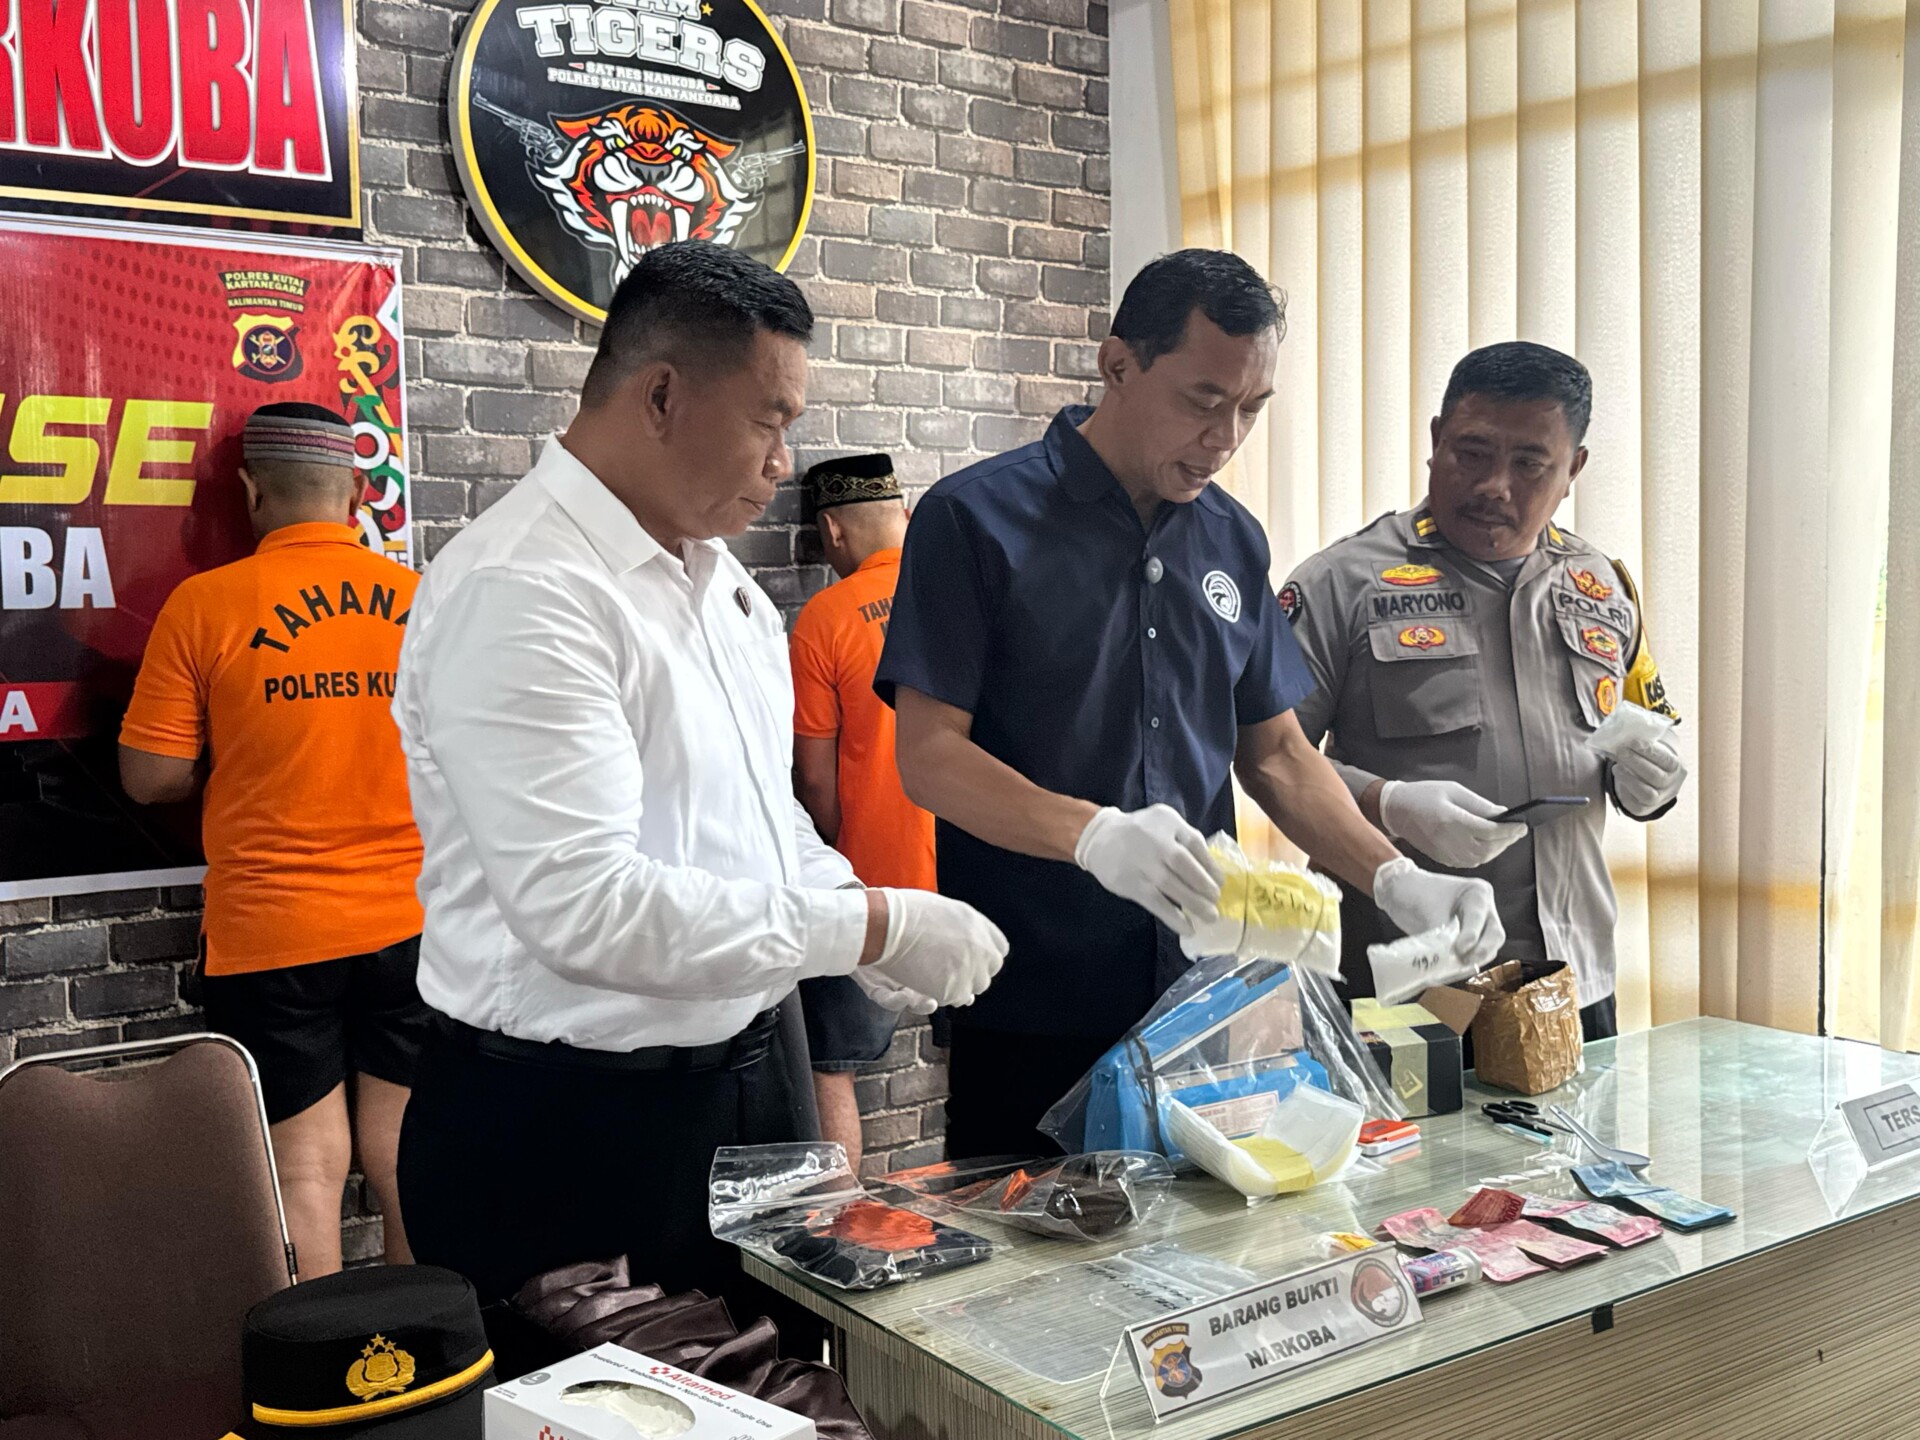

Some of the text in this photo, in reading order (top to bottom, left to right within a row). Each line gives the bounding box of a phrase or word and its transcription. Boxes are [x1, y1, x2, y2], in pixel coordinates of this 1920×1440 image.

[516, 4, 766, 92] TIGERS
[547, 67, 599, 89] POLRES
[601, 76, 643, 96] KUTAI
[585, 61, 615, 79] SAT
[616, 66, 642, 82] RES
[0, 0, 332, 182] KOBA
[225, 273, 304, 288] POLRES KUTAI
[225, 280, 304, 296] KARTANEGARA
[228, 298, 304, 312] KALIMANTAN TIMUR
[0, 394, 214, 506] SE
[0, 526, 116, 610] BA
[858, 596, 893, 623] TAH
[1373, 592, 1465, 617] MARYONO
[1559, 592, 1628, 631] POLRI
[264, 671, 360, 703] POLRES
[1208, 1296, 1282, 1336] BARANG
[1284, 1277, 1339, 1310] BUKTI
[1245, 1325, 1336, 1369] NARKOBA
[668, 1373, 736, 1400] Altamed
